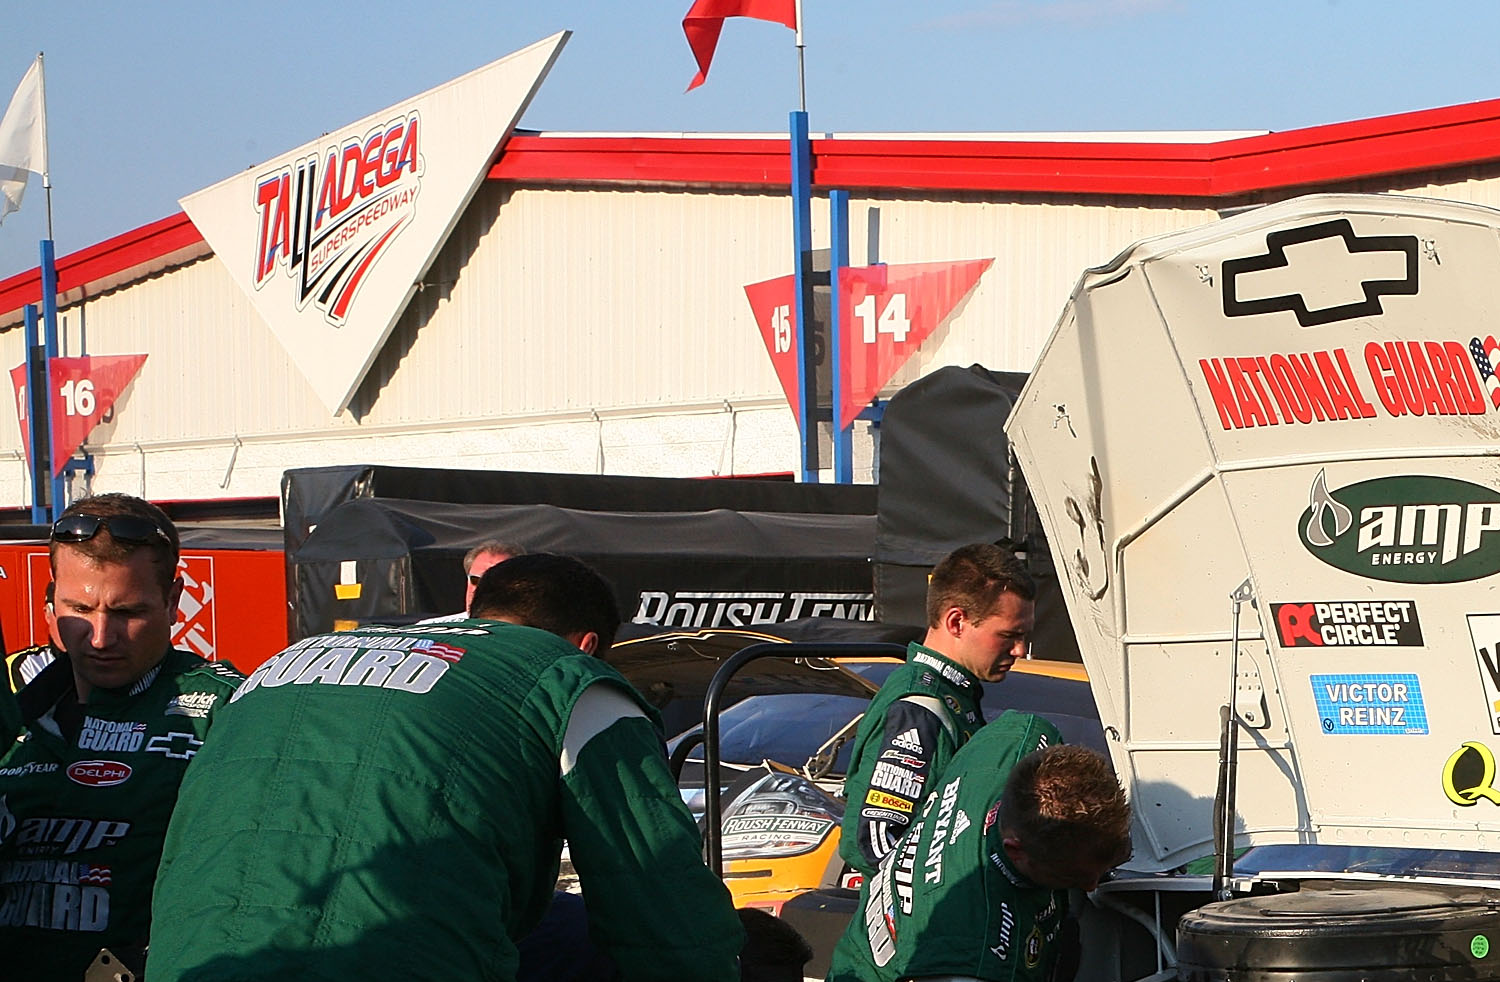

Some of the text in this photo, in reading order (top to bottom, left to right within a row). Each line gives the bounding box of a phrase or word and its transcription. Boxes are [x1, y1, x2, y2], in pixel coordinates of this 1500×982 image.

[257, 116, 418, 303] TALLADEGA
[310, 185, 418, 274] SUPERSPEEDWAY
[771, 304, 791, 354] 15
[855, 293, 910, 344] 14
[1199, 340, 1487, 431] NATIONAL GUARD
[60, 379, 96, 416] 16
[1371, 551, 1438, 566] ENERGY
[1316, 602, 1411, 624] PERFECT
[1320, 623, 1400, 646] CIRCLE
[1325, 682, 1409, 704] VICTOR
[84, 714, 134, 732] NATIONAL
[1339, 706, 1407, 727] REINZ
[78, 728, 146, 752] GUARD
[891, 738, 924, 755] adidas
[74, 766, 126, 778] DELPHI
[875, 761, 915, 781] NATIONAL
[870, 774, 924, 800] GUARD
[881, 795, 912, 812] BOSCH
[723, 816, 826, 836] ROUSH FENWAY
[924, 777, 962, 885] BRYANT
